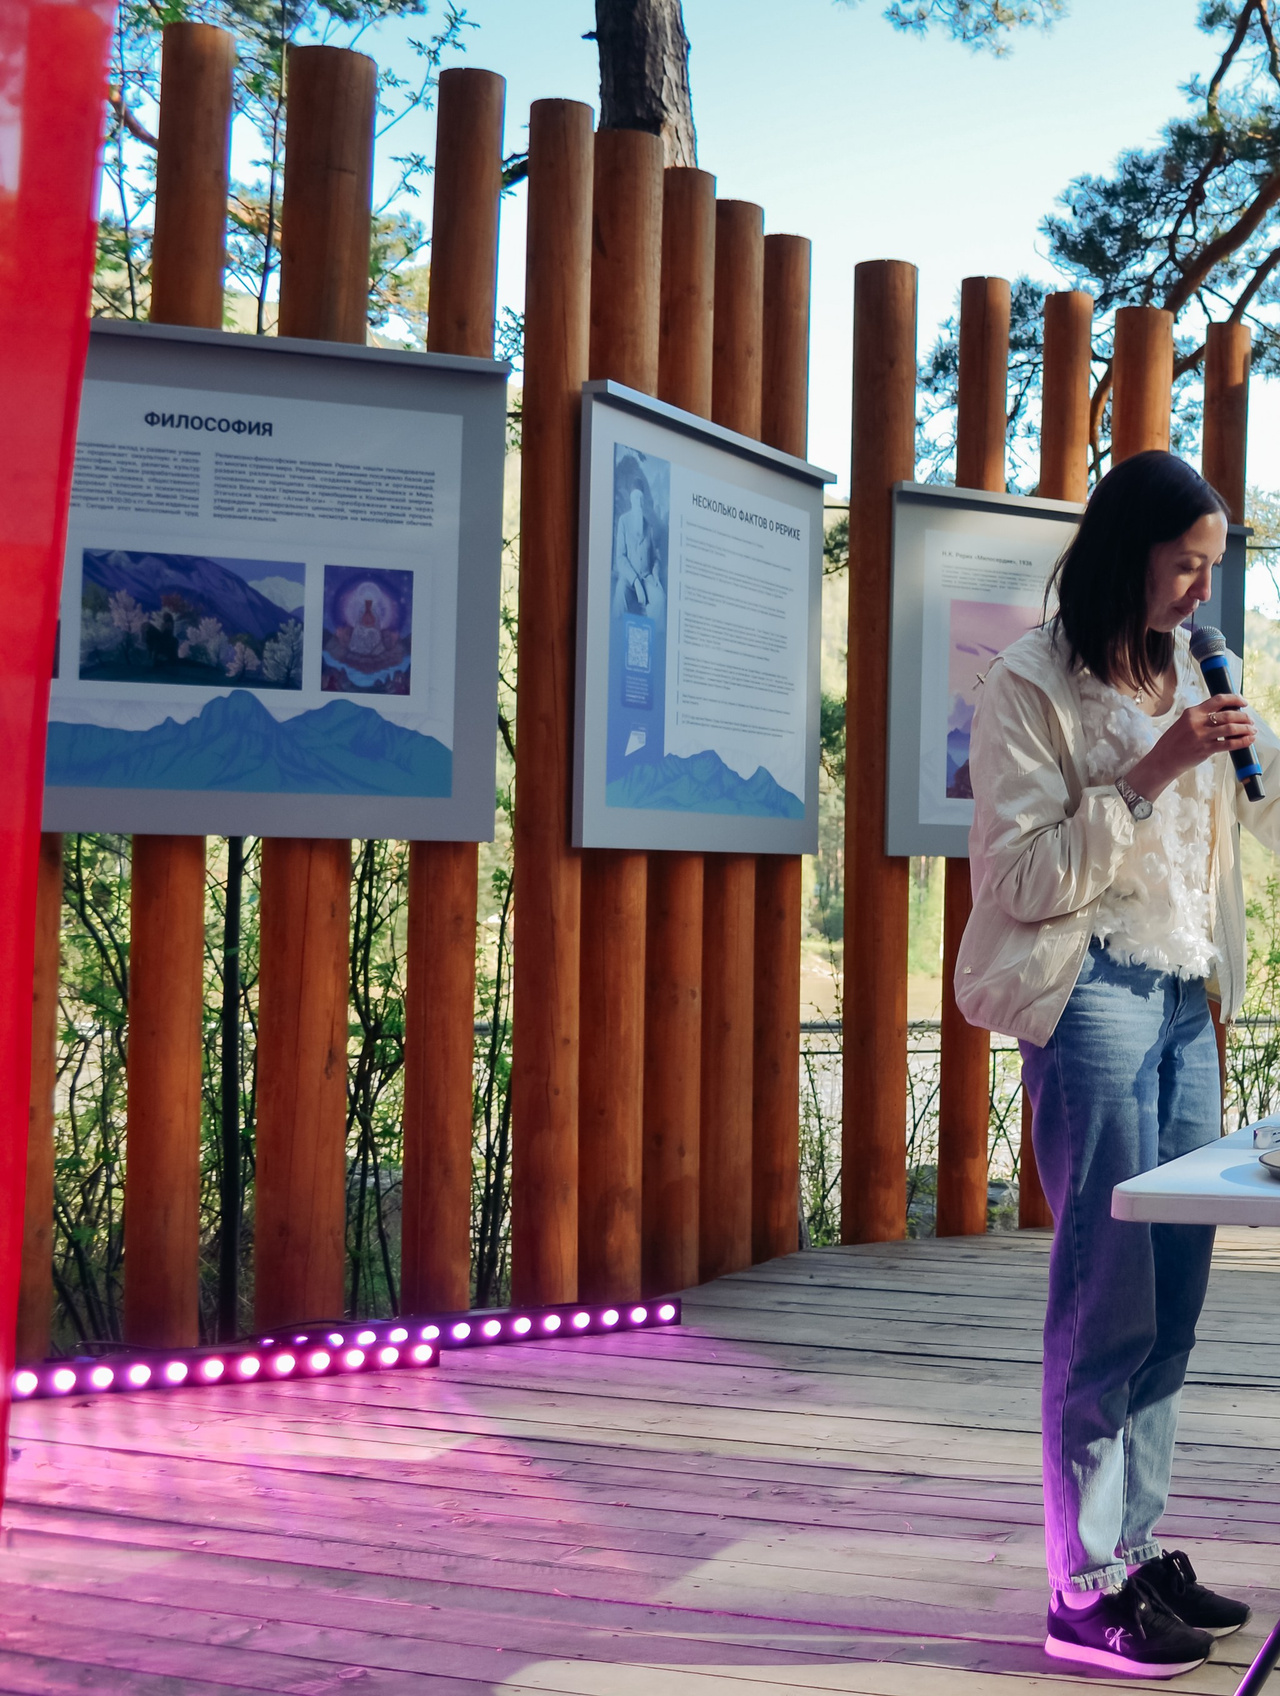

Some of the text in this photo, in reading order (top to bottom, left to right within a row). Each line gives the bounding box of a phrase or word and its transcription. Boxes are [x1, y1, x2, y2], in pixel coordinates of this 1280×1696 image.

[144, 411, 274, 437] ФИЛОСОФИЯ
[692, 493, 737, 518] НЕСКОЛЬКО
[739, 510, 768, 529] ФАКТОВ
[769, 520, 774, 531] О
[775, 522, 800, 541] РЕРИХЕ
